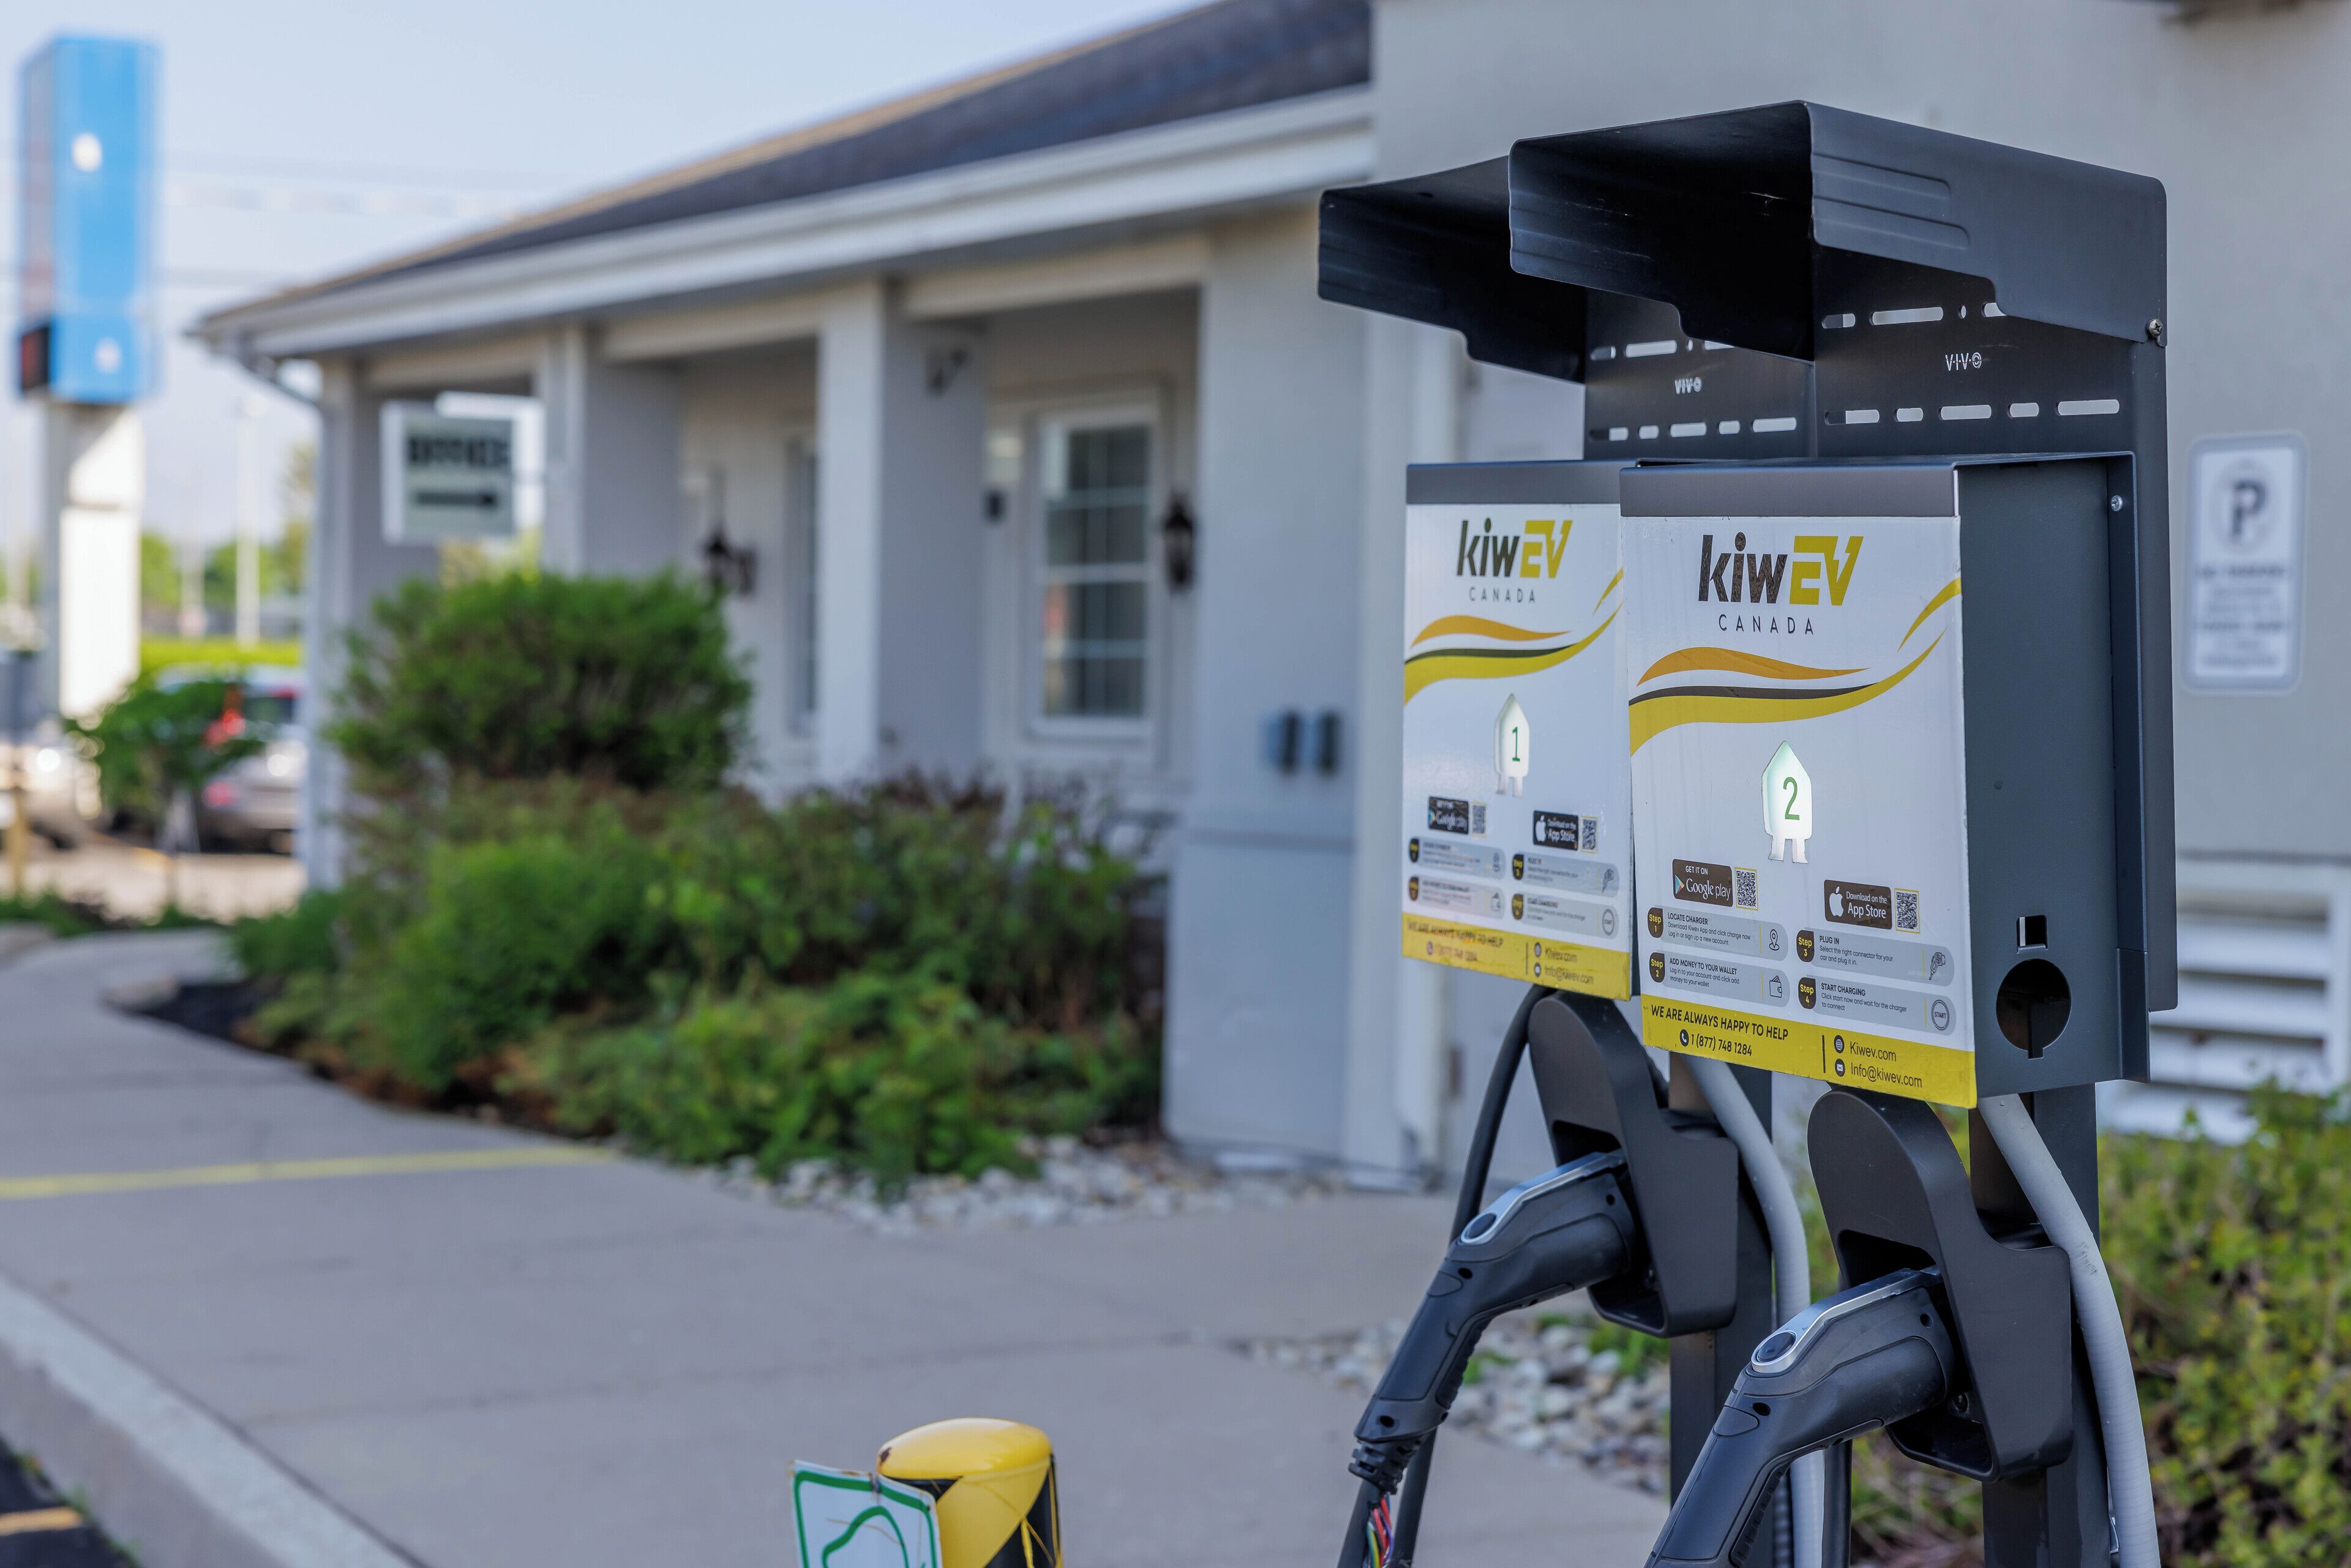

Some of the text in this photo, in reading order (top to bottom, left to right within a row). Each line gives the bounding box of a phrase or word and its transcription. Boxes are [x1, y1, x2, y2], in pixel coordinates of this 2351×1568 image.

[2232, 479, 2268, 535] P
[1457, 517, 1573, 579] kiwEV
[1698, 532, 1864, 606] kiwEV
[1469, 586, 1536, 604] CANADA
[1719, 614, 1813, 635] CANADA
[1512, 727, 1520, 762] 1
[1782, 776, 1800, 821] 2
[1548, 828, 1575, 842] App Store
[1686, 879, 1730, 901] Google play
[1847, 891, 1870, 902] Download
[1878, 895, 1887, 904] the
[1668, 912, 1708, 925] LOCATE CHARGER
[1848, 903, 1886, 918] App Store
[1649, 913, 1662, 925] Step
[1668, 922, 1687, 931] Download
[1700, 926, 1708, 935] App
[1727, 930, 1741, 940] charge
[1685, 932, 1693, 942] sign
[1799, 937, 1812, 948] Step
[1820, 936, 1832, 944] PLUG
[1838, 956, 1848, 965] plug
[1842, 948, 1852, 957] right
[1853, 950, 1875, 959] connector
[1651, 959, 1663, 970] Step
[1669, 958, 1738, 975] ADD MONEY TO YOUR WALLET
[1800, 985, 1813, 996] Step
[1821, 983, 1866, 996] START CHARGING
[1889, 1004, 1907, 1013] charger
[1651, 1004, 1788, 1041] WE ARE ALWAYS HAPPY TO HELP
[1691, 1033, 1752, 1056] 1 (877) 748 1284
[1850, 1041, 1897, 1062] Kiwev.com
[1851, 1062, 1922, 1088] Info@kiwev.com
